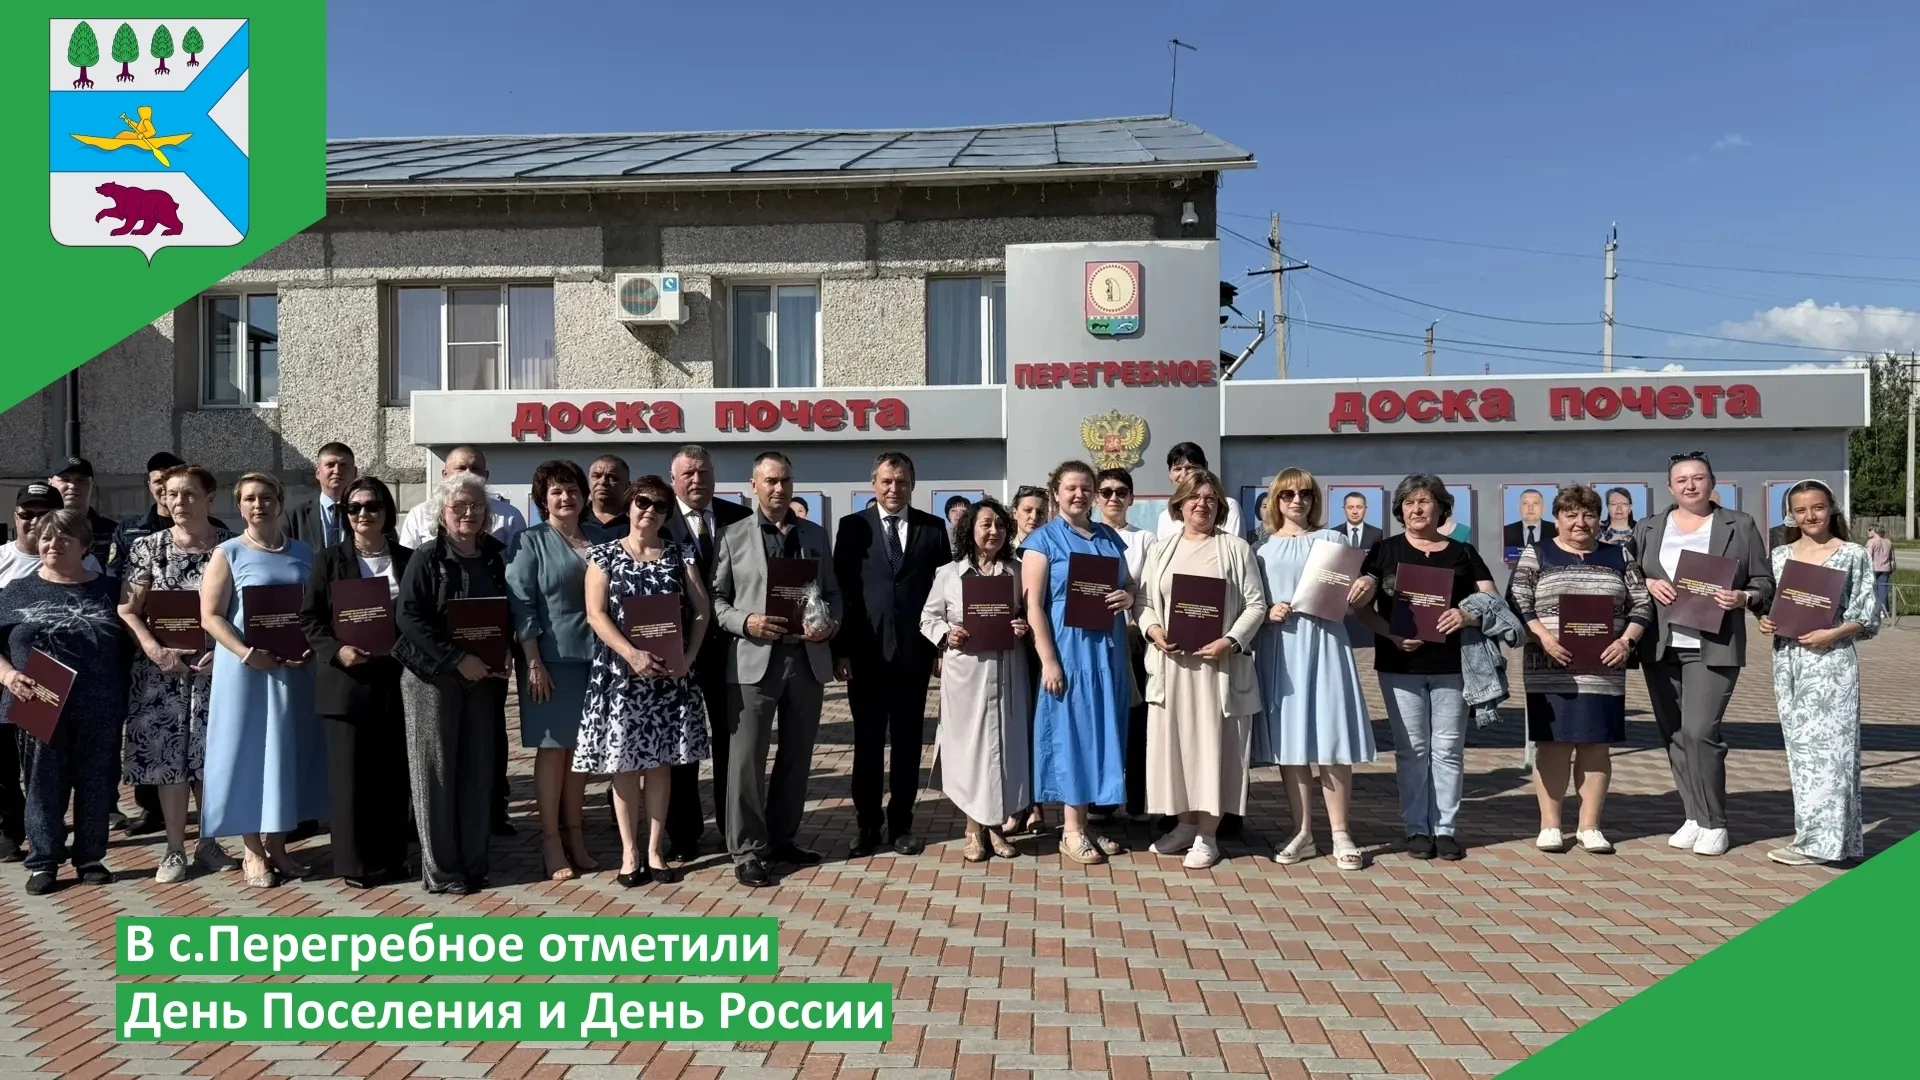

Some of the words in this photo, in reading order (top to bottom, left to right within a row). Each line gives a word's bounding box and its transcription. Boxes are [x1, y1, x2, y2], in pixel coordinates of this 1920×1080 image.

[1014, 360, 1213, 386] ПЕРЕГРЕБНОЕ
[511, 400, 682, 438] доска
[715, 396, 908, 430] почета
[1328, 387, 1513, 430] доска
[1548, 383, 1760, 418] почета
